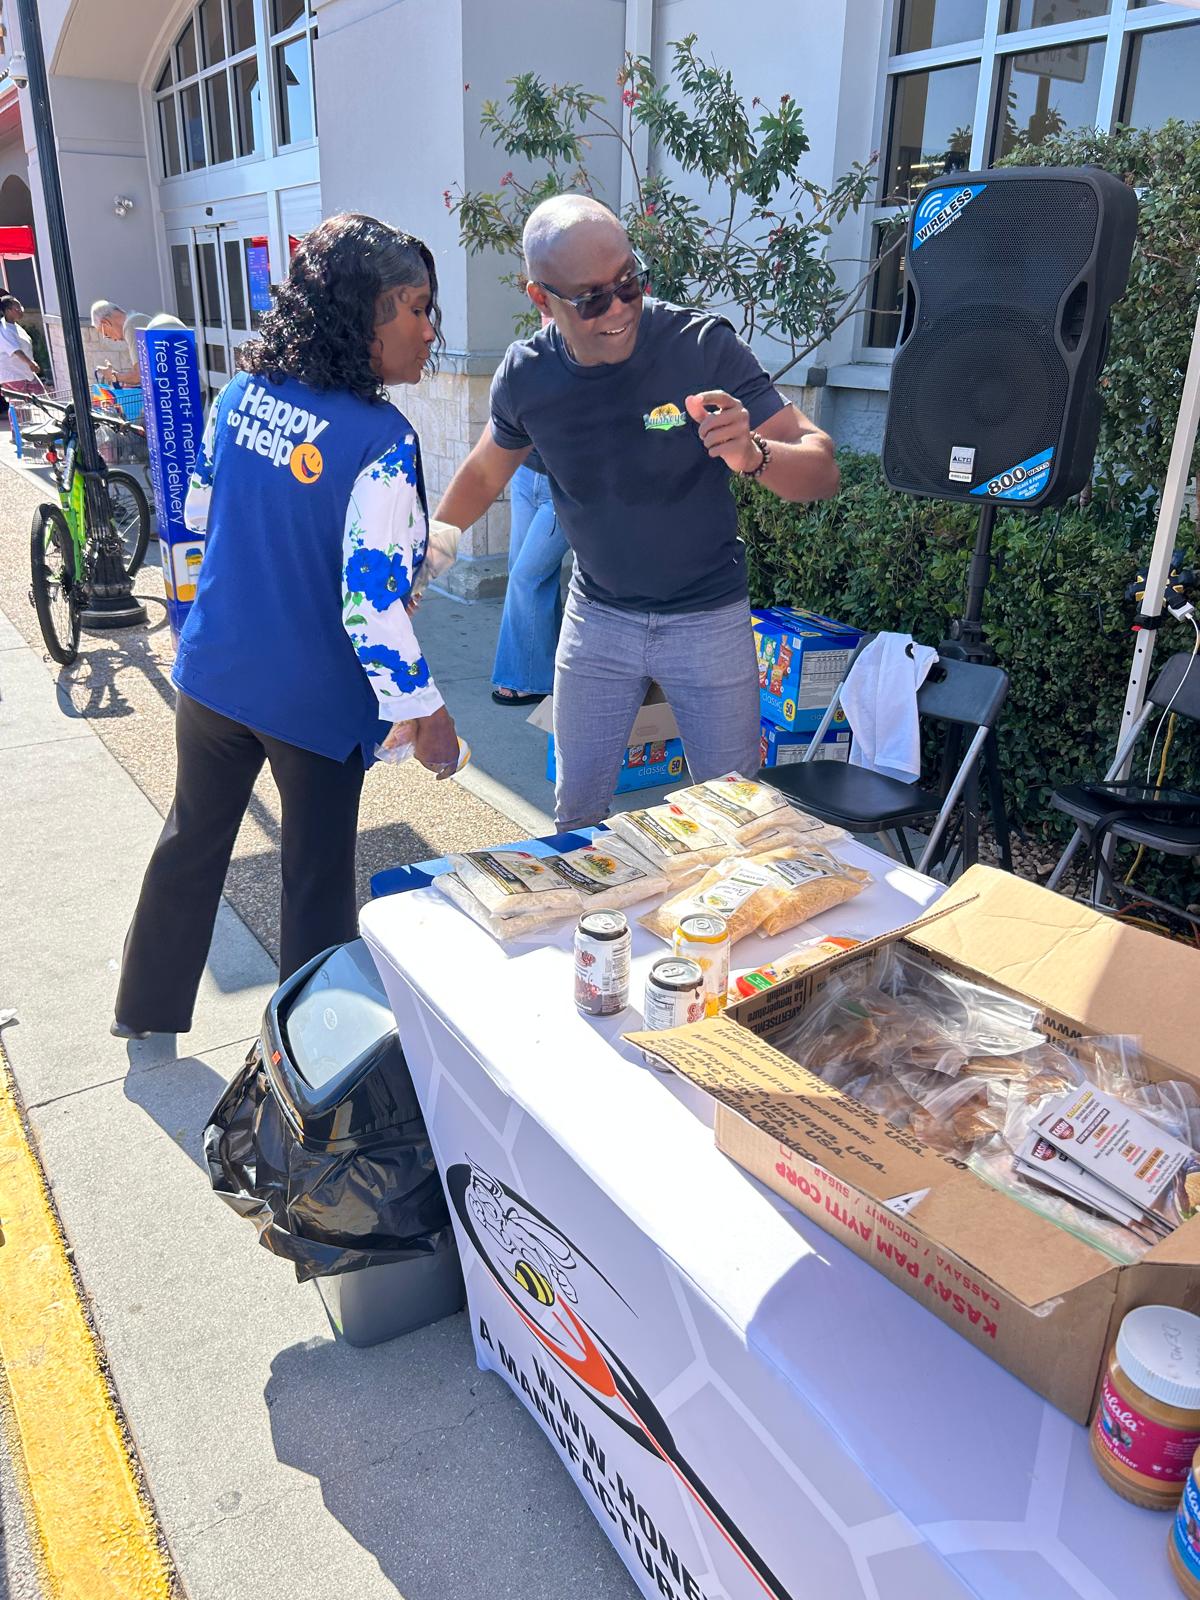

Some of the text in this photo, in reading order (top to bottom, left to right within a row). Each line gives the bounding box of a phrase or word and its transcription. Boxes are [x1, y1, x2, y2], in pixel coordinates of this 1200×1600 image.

[917, 189, 972, 241] WIRELESS
[154, 340, 184, 525] free pharmacy delivery
[173, 340, 197, 485] Walmart+ memb
[239, 384, 329, 443] Happy
[227, 410, 293, 468] to Help
[988, 466, 1027, 495] 800
[785, 703, 793, 715] 50
[638, 759, 681, 777] classic 50
[686, 1052, 723, 1075] Lake
[725, 1077, 756, 1099] City,
[760, 1100, 800, 1129] Utah,
[805, 1130, 845, 1159] USA.
[691, 1034, 876, 1145] Manufacturing locations:
[806, 1082, 826, 1094] IN
[750, 1104, 788, 1131] USA.
[776, 1102, 838, 1144] Indiana,
[844, 1145, 887, 1174] USA.
[775, 1161, 821, 1204] CORP
[814, 1166, 850, 1198] SUGAR
[825, 1196, 872, 1243] AYITI
[865, 1204, 919, 1249] COCONUT
[876, 1235, 919, 1278] PAM
[936, 1255, 1001, 1311] CASSAVA
[480, 1316, 681, 1600] A MANUFACTUR
[532, 1354, 708, 1600] WWW.HONE
[1113, 1446, 1139, 1470] Butter
